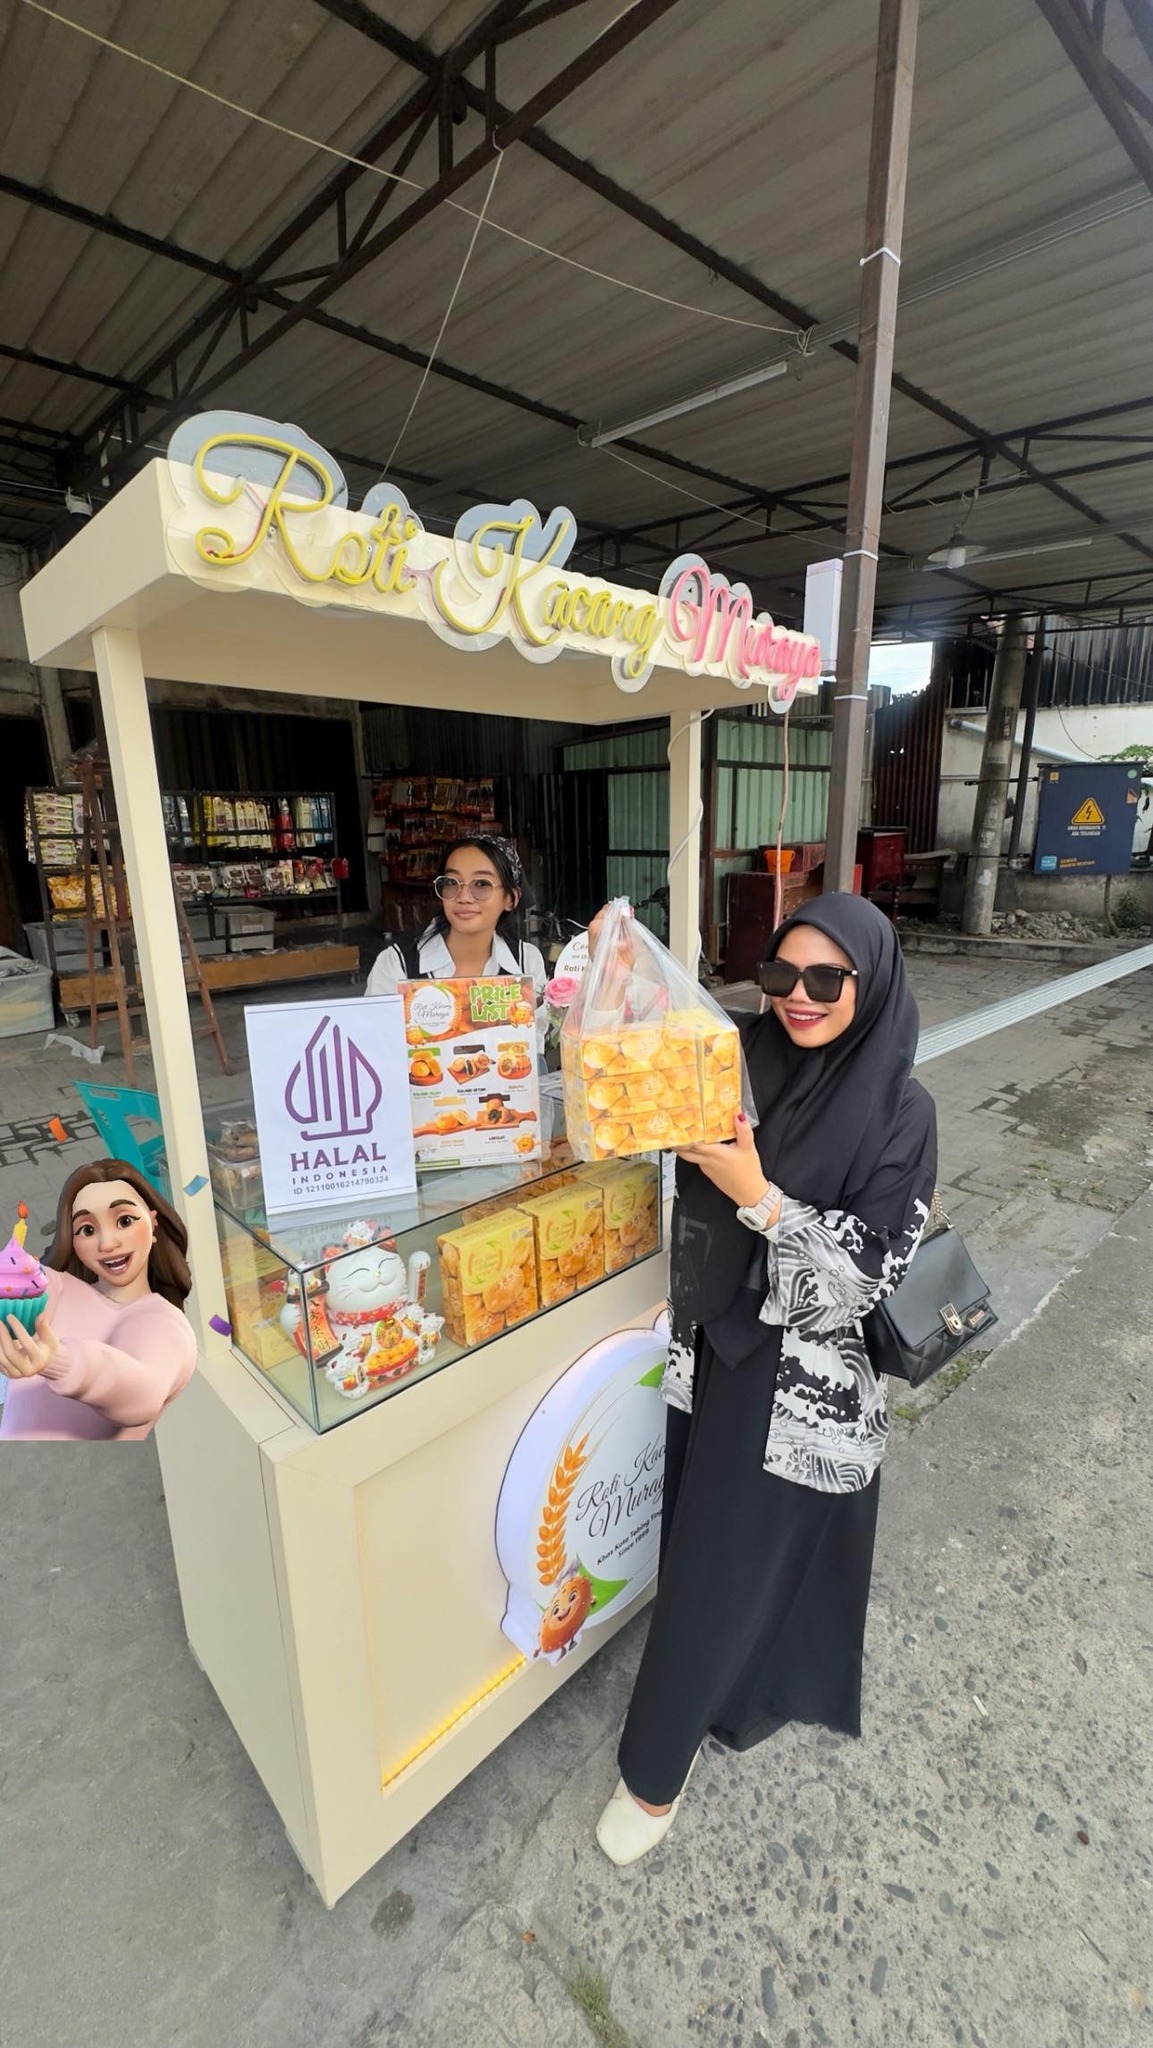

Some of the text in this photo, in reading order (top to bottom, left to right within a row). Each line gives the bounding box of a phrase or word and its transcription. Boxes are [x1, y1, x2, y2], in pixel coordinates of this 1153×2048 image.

[196, 433, 418, 593] Roti
[435, 514, 665, 679] Kacang
[470, 984, 522, 1004] PRICE
[471, 1003, 512, 1022] LIST
[290, 1142, 387, 1172] HALAL
[292, 1165, 387, 1185] INDONESIA
[293, 1187, 303, 1195] ID
[576, 1433, 666, 1521] Roti Kac
